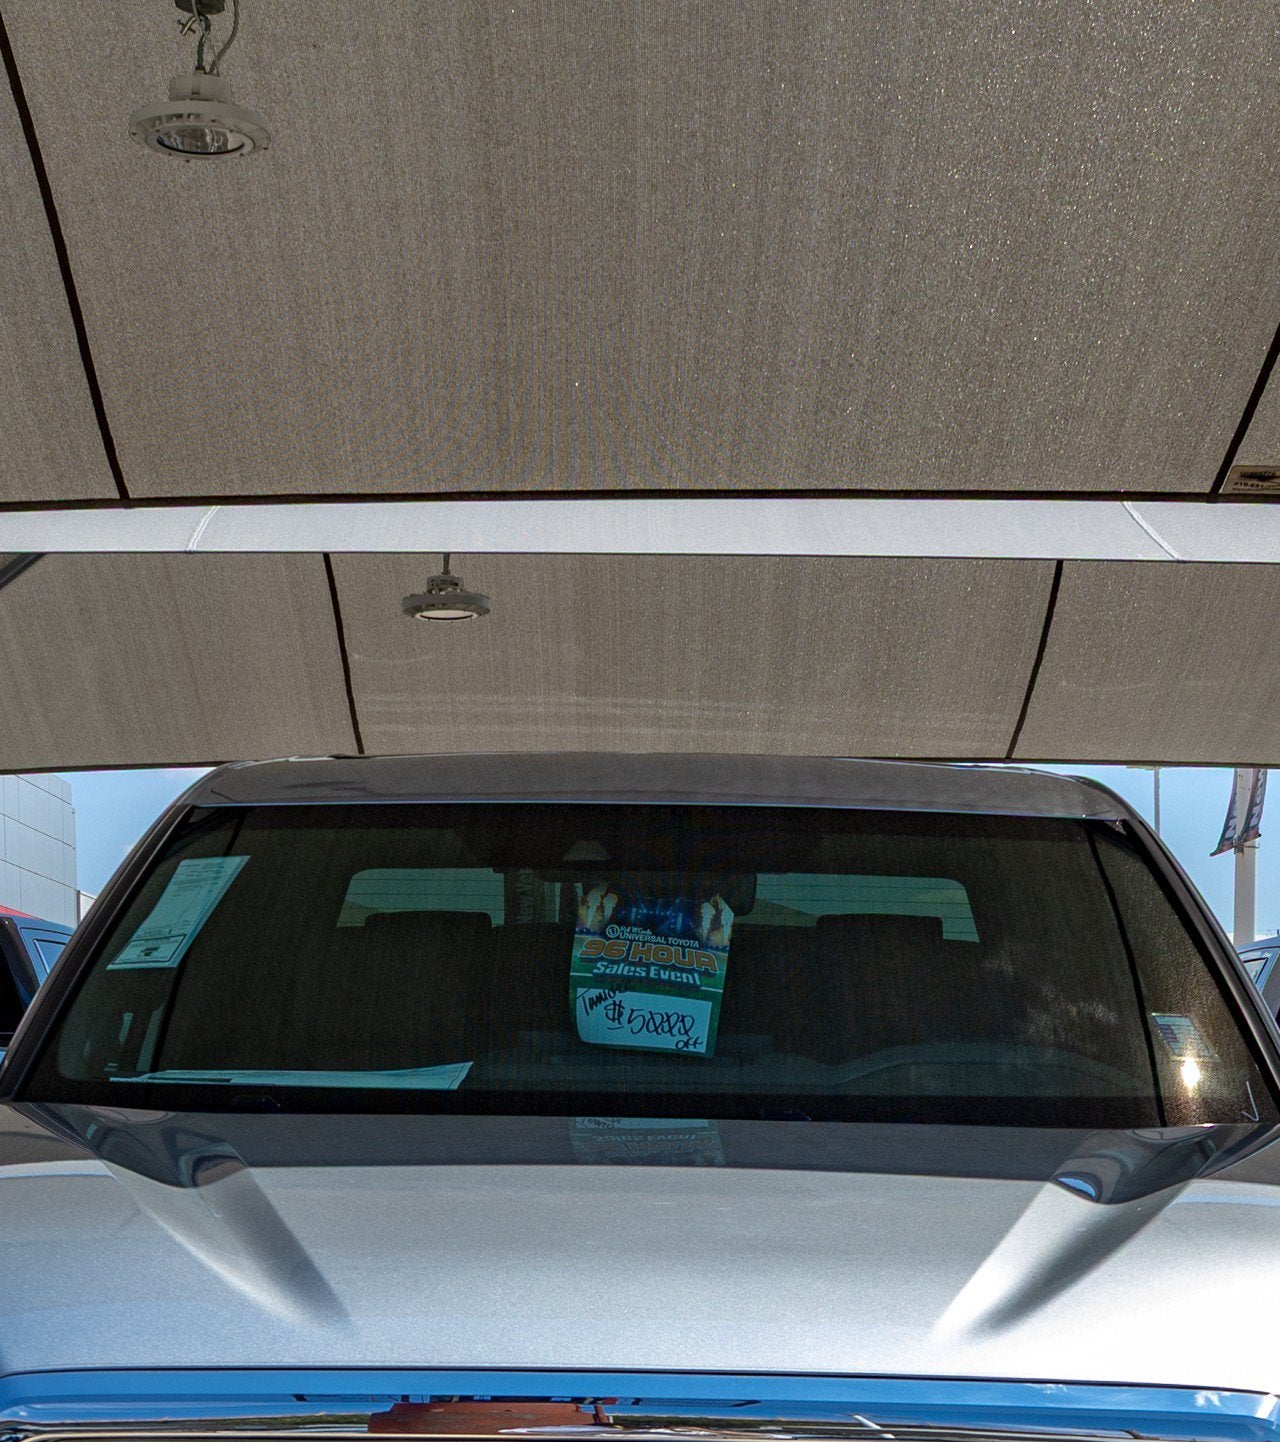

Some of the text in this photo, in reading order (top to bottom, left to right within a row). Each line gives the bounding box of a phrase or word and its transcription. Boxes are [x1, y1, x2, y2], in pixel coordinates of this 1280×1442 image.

[619, 932, 700, 948] UNIVERSAL TOYOTA
[578, 938, 719, 974] 96 HOUR
[592, 961, 701, 986] Sales Event
